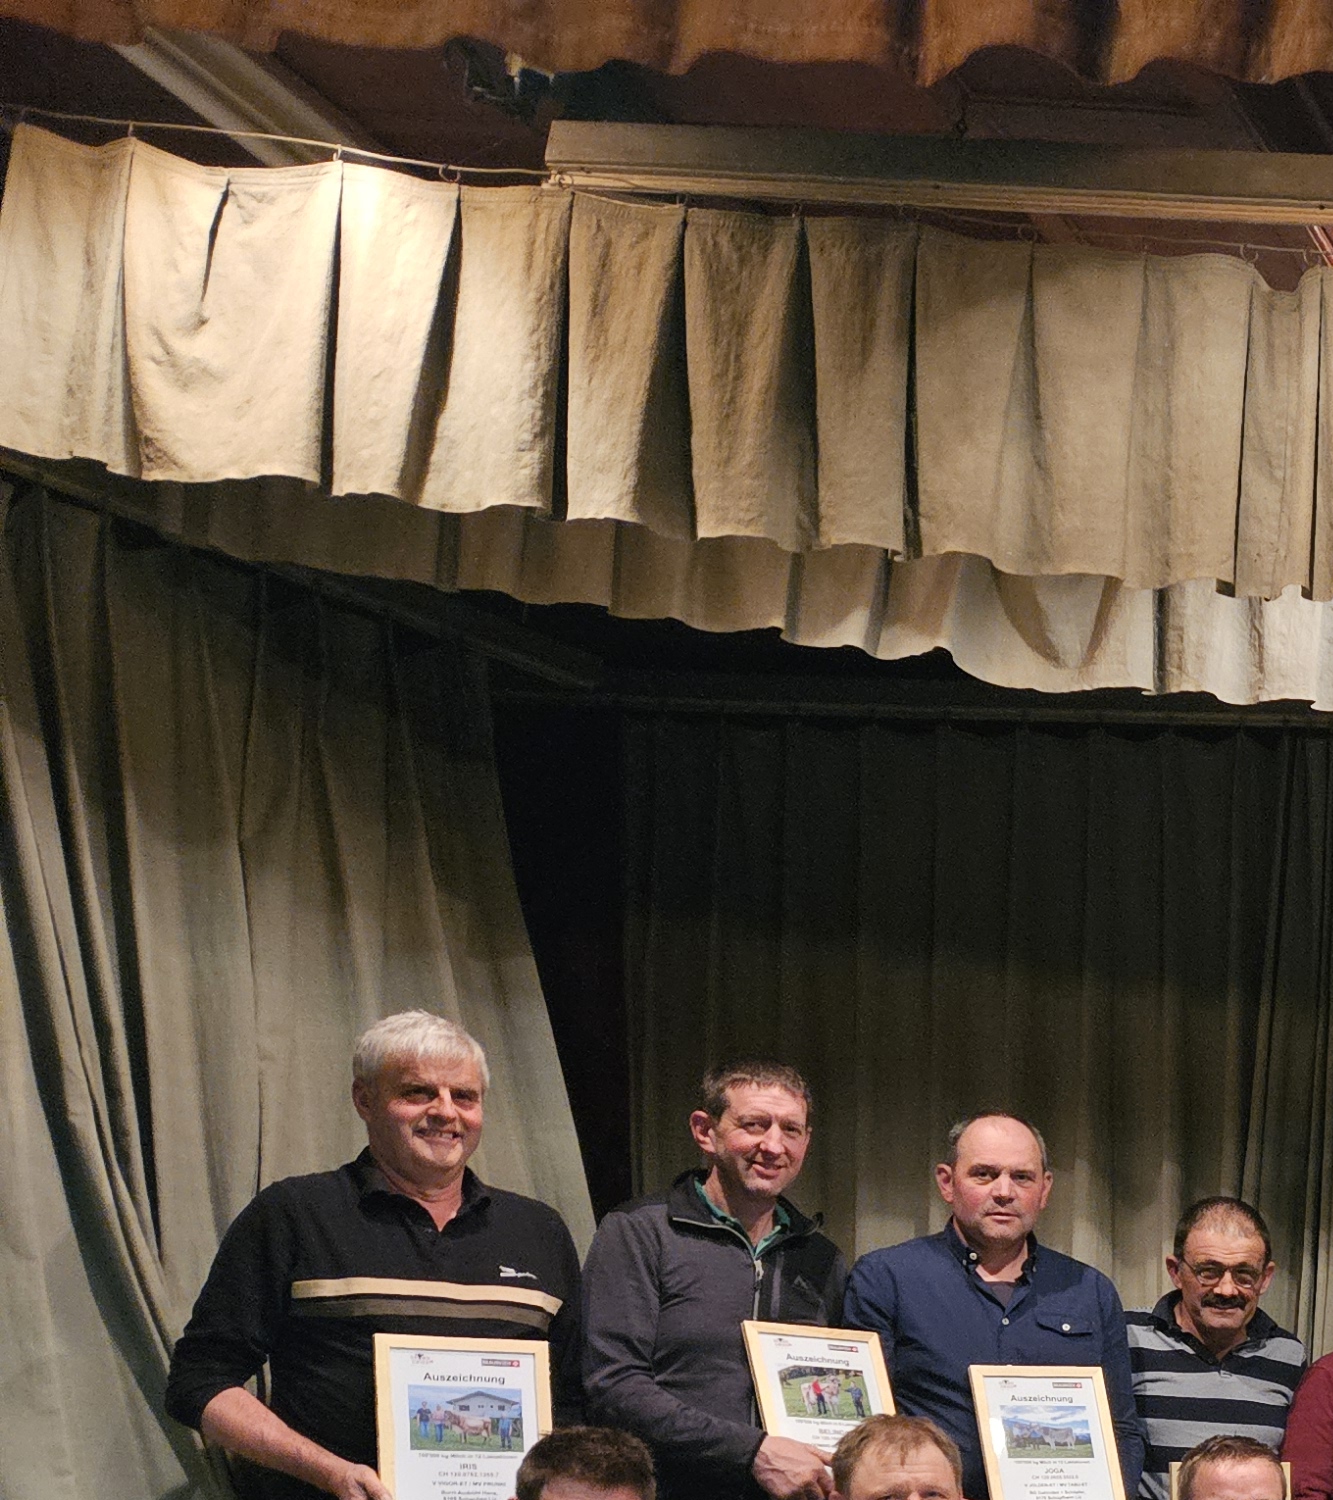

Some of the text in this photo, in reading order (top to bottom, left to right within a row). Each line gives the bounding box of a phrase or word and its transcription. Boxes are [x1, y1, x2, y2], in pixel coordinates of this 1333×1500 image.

[786, 1354, 849, 1366] Auszeichnung
[423, 1373, 506, 1385] Auszeichnung
[1011, 1395, 1073, 1403] Auszeichnung
